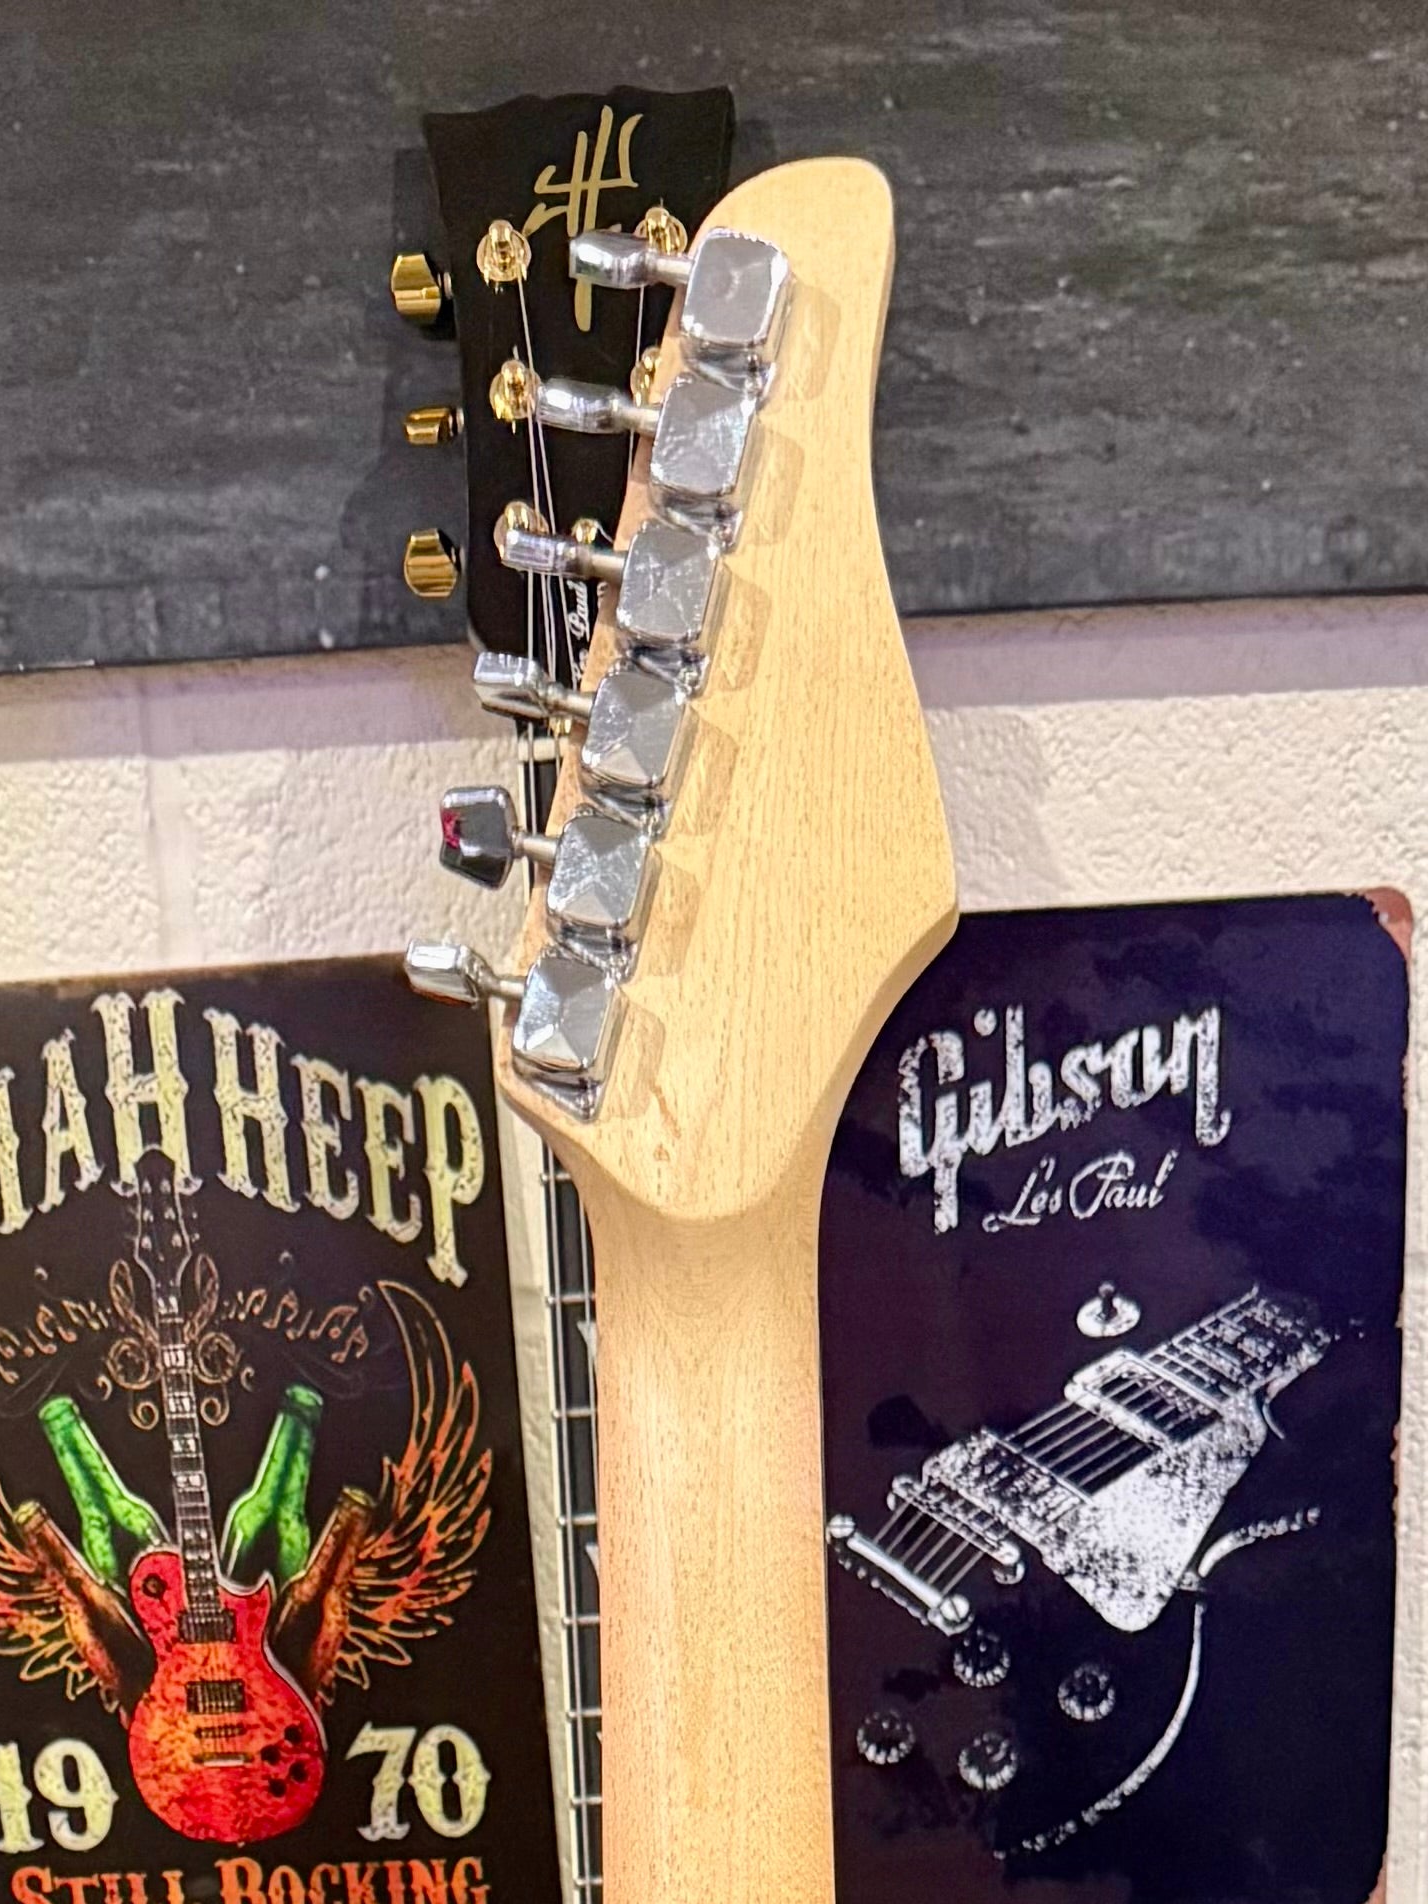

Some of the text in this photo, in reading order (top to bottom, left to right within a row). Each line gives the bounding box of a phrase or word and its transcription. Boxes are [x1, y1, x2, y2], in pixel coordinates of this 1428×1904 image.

[202, 1005, 487, 1288] HEEP
[897, 1002, 1232, 1235] Gibson
[982, 1149, 1177, 1234] Les Paul
[344, 1720, 492, 1843] 70
